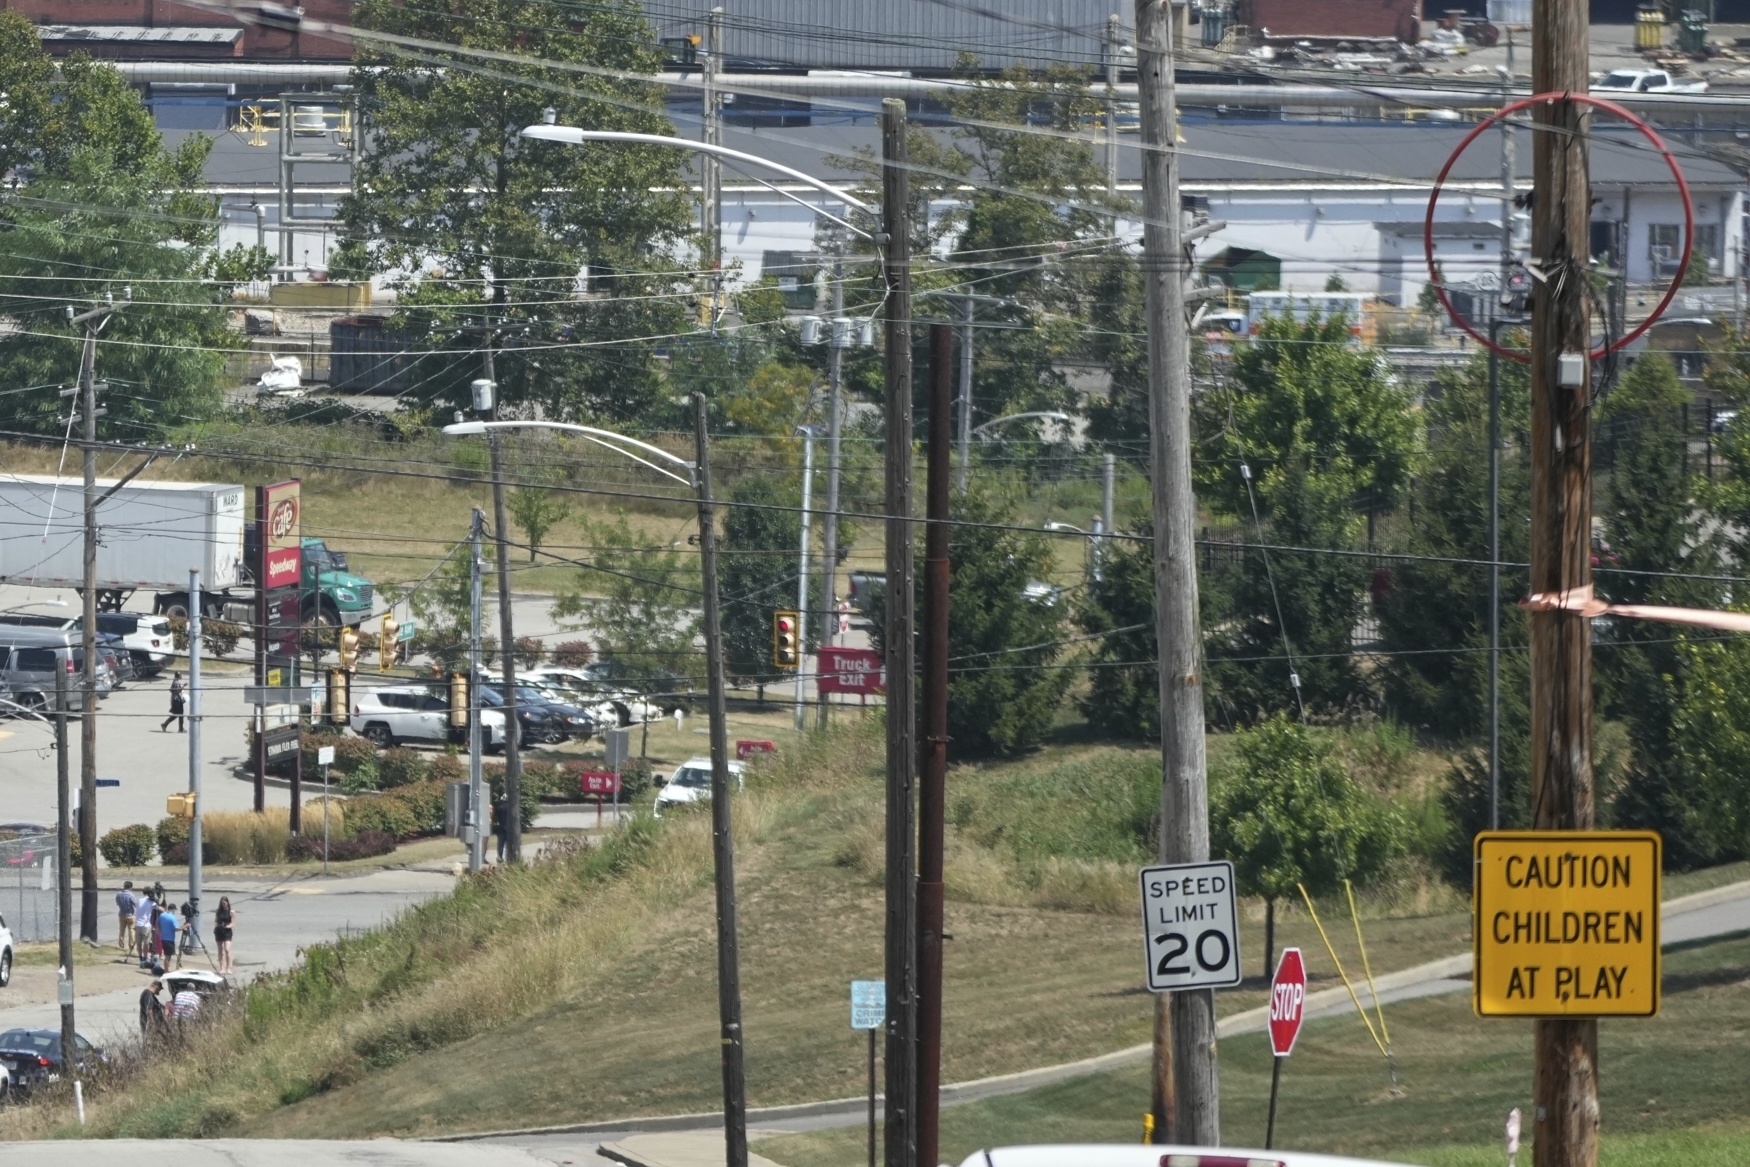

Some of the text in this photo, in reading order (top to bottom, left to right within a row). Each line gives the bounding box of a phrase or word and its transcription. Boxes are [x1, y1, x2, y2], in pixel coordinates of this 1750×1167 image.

[269, 558, 297, 578] Speedway
[833, 655, 871, 671] Truck
[839, 671, 866, 686] Exit
[1505, 854, 1631, 890] CAUTION
[1150, 876, 1226, 899] SPEED
[1159, 902, 1218, 924] LIMIT
[1492, 910, 1643, 945] CHILDREN
[1153, 929, 1230, 976] 20
[1505, 966, 1629, 1000] AT PLAY
[1271, 983, 1303, 1021] STOP
[854, 1017, 883, 1026] WATC
